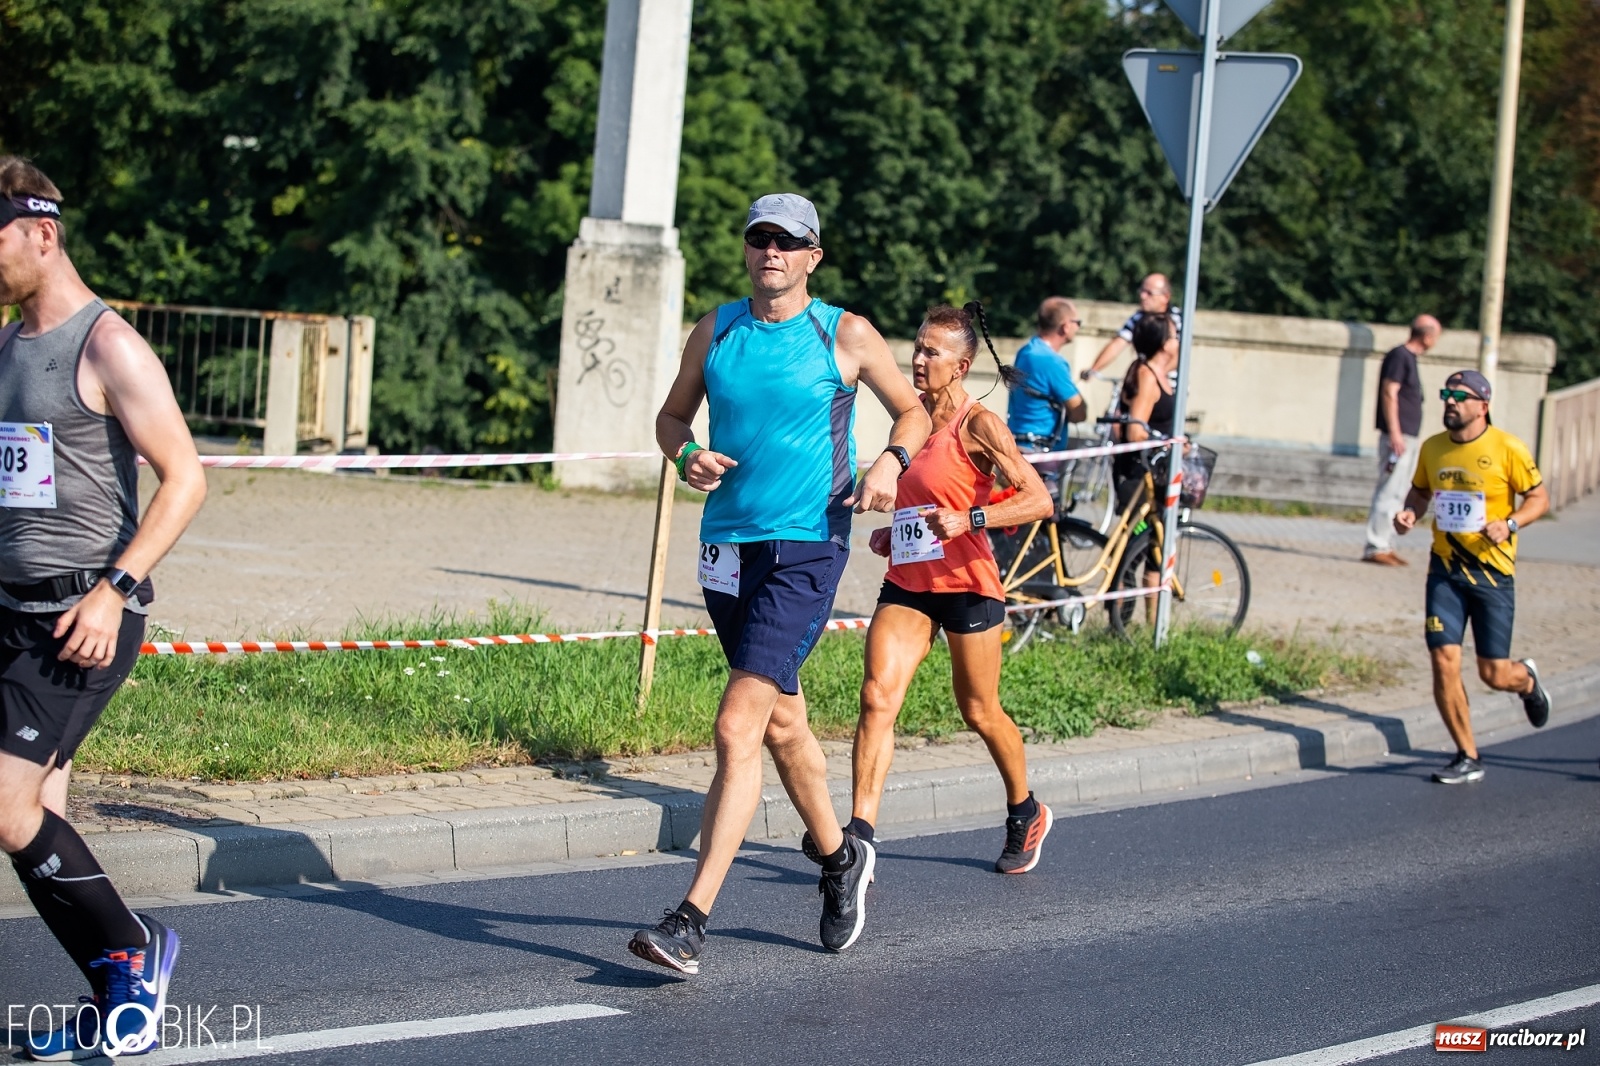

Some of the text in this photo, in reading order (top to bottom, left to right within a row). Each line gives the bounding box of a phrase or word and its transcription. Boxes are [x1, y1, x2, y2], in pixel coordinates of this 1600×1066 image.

[0, 446, 28, 473] 03
[1448, 502, 1472, 516] 319
[900, 521, 923, 542] 196
